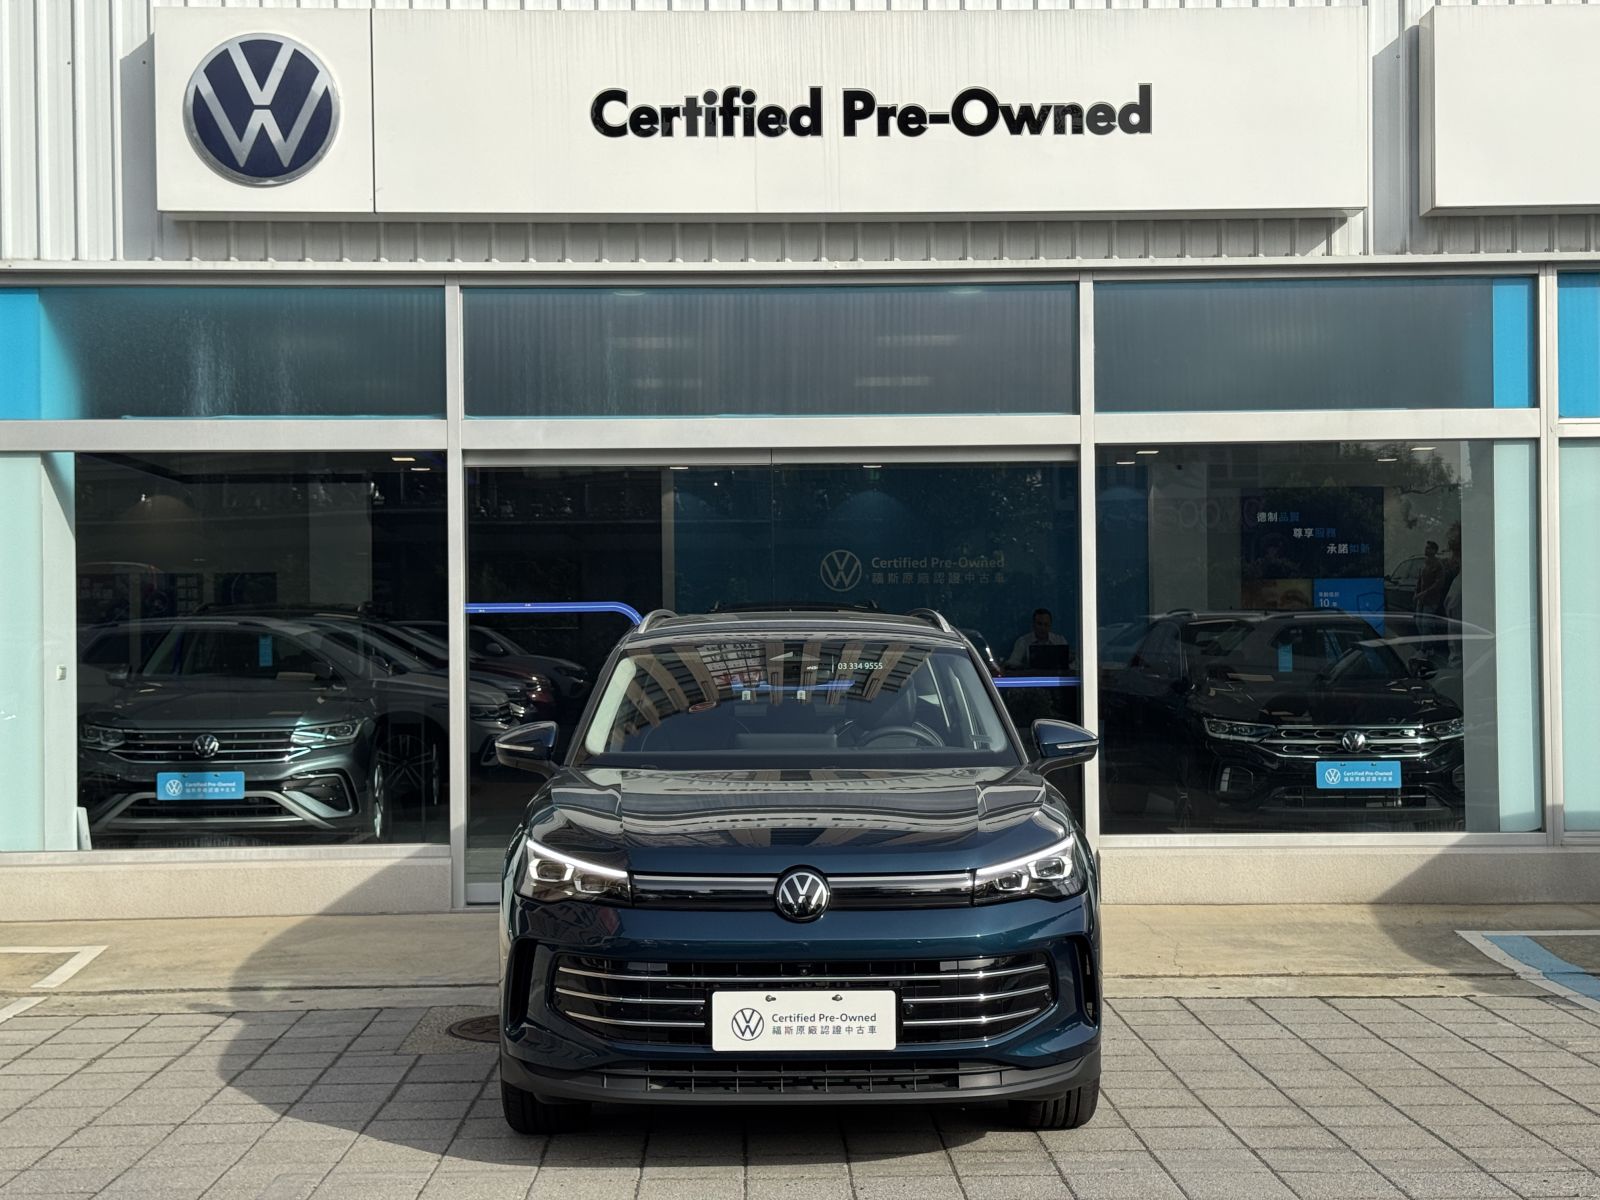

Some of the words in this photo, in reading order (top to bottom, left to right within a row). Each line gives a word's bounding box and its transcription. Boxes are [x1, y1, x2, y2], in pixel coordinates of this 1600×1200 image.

[184, 34, 340, 186] VW
[590, 86, 824, 138] Certified
[842, 82, 1153, 137] Pre-Owned
[820, 549, 862, 592] VW
[871, 557, 928, 569] Certified
[931, 557, 1005, 569] Pre-Owned
[837, 662, 847, 670] 03
[849, 662, 863, 670] 334
[864, 662, 883, 670] 9555
[778, 871, 828, 919] VW
[731, 1007, 765, 1041] VW
[771, 1013, 816, 1023] Certified
[818, 1013, 877, 1022] Pre-Owned
[772, 1025, 877, 1035] 福斯原廠認證中古車
